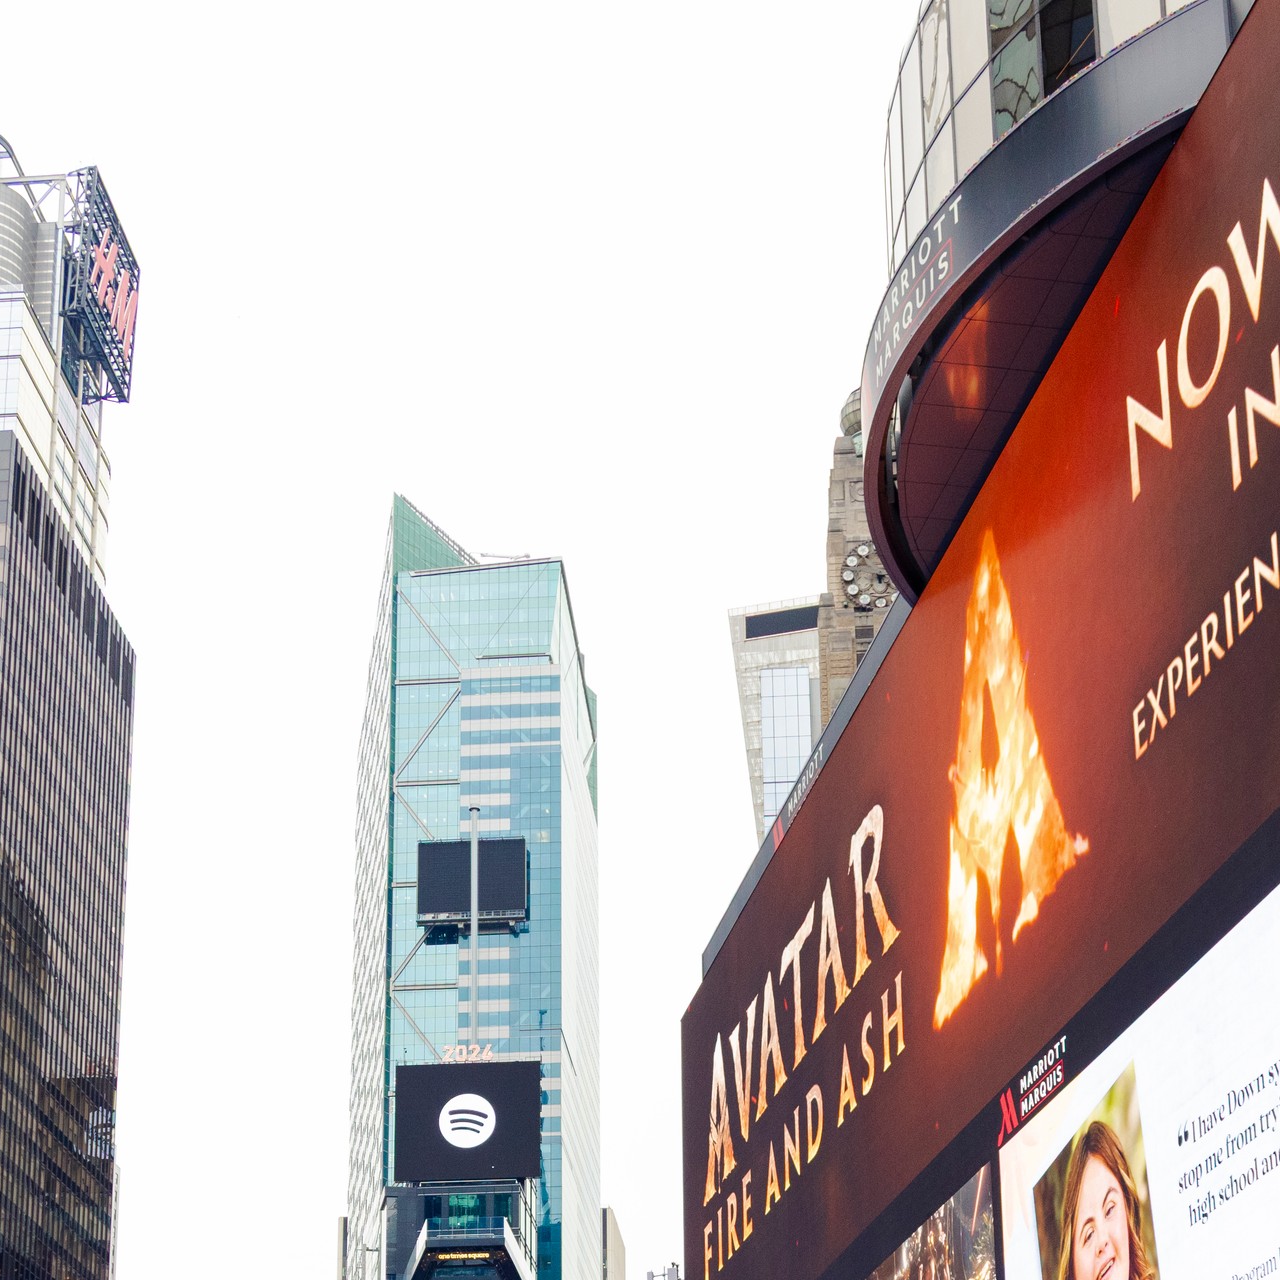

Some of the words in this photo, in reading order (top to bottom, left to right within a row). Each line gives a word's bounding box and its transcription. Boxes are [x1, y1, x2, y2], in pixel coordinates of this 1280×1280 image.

[90, 228, 139, 360] H&M
[873, 195, 962, 353] MARRIOTT
[876, 251, 950, 388] MARQUIS
[787, 743, 824, 818] MARRIOTT
[703, 803, 901, 1207] AVATAR
[765, 1084, 823, 1216] AND
[837, 971, 906, 1128] ASH
[1020, 1035, 1067, 1095] MARRIOTT
[1021, 1065, 1063, 1117] MARQUIS
[1196, 1103, 1226, 1138] have
[1226, 1069, 1265, 1116] Down
[1178, 1162, 1203, 1194] stop
[1204, 1144, 1223, 1170] me
[1225, 1120, 1258, 1161] from
[1188, 1190, 1216, 1228] high
[1218, 1156, 1259, 1206] school
[438, 1252, 450, 1260] one
[451, 1252, 467, 1260] times
[467, 1252, 490, 1260] square
